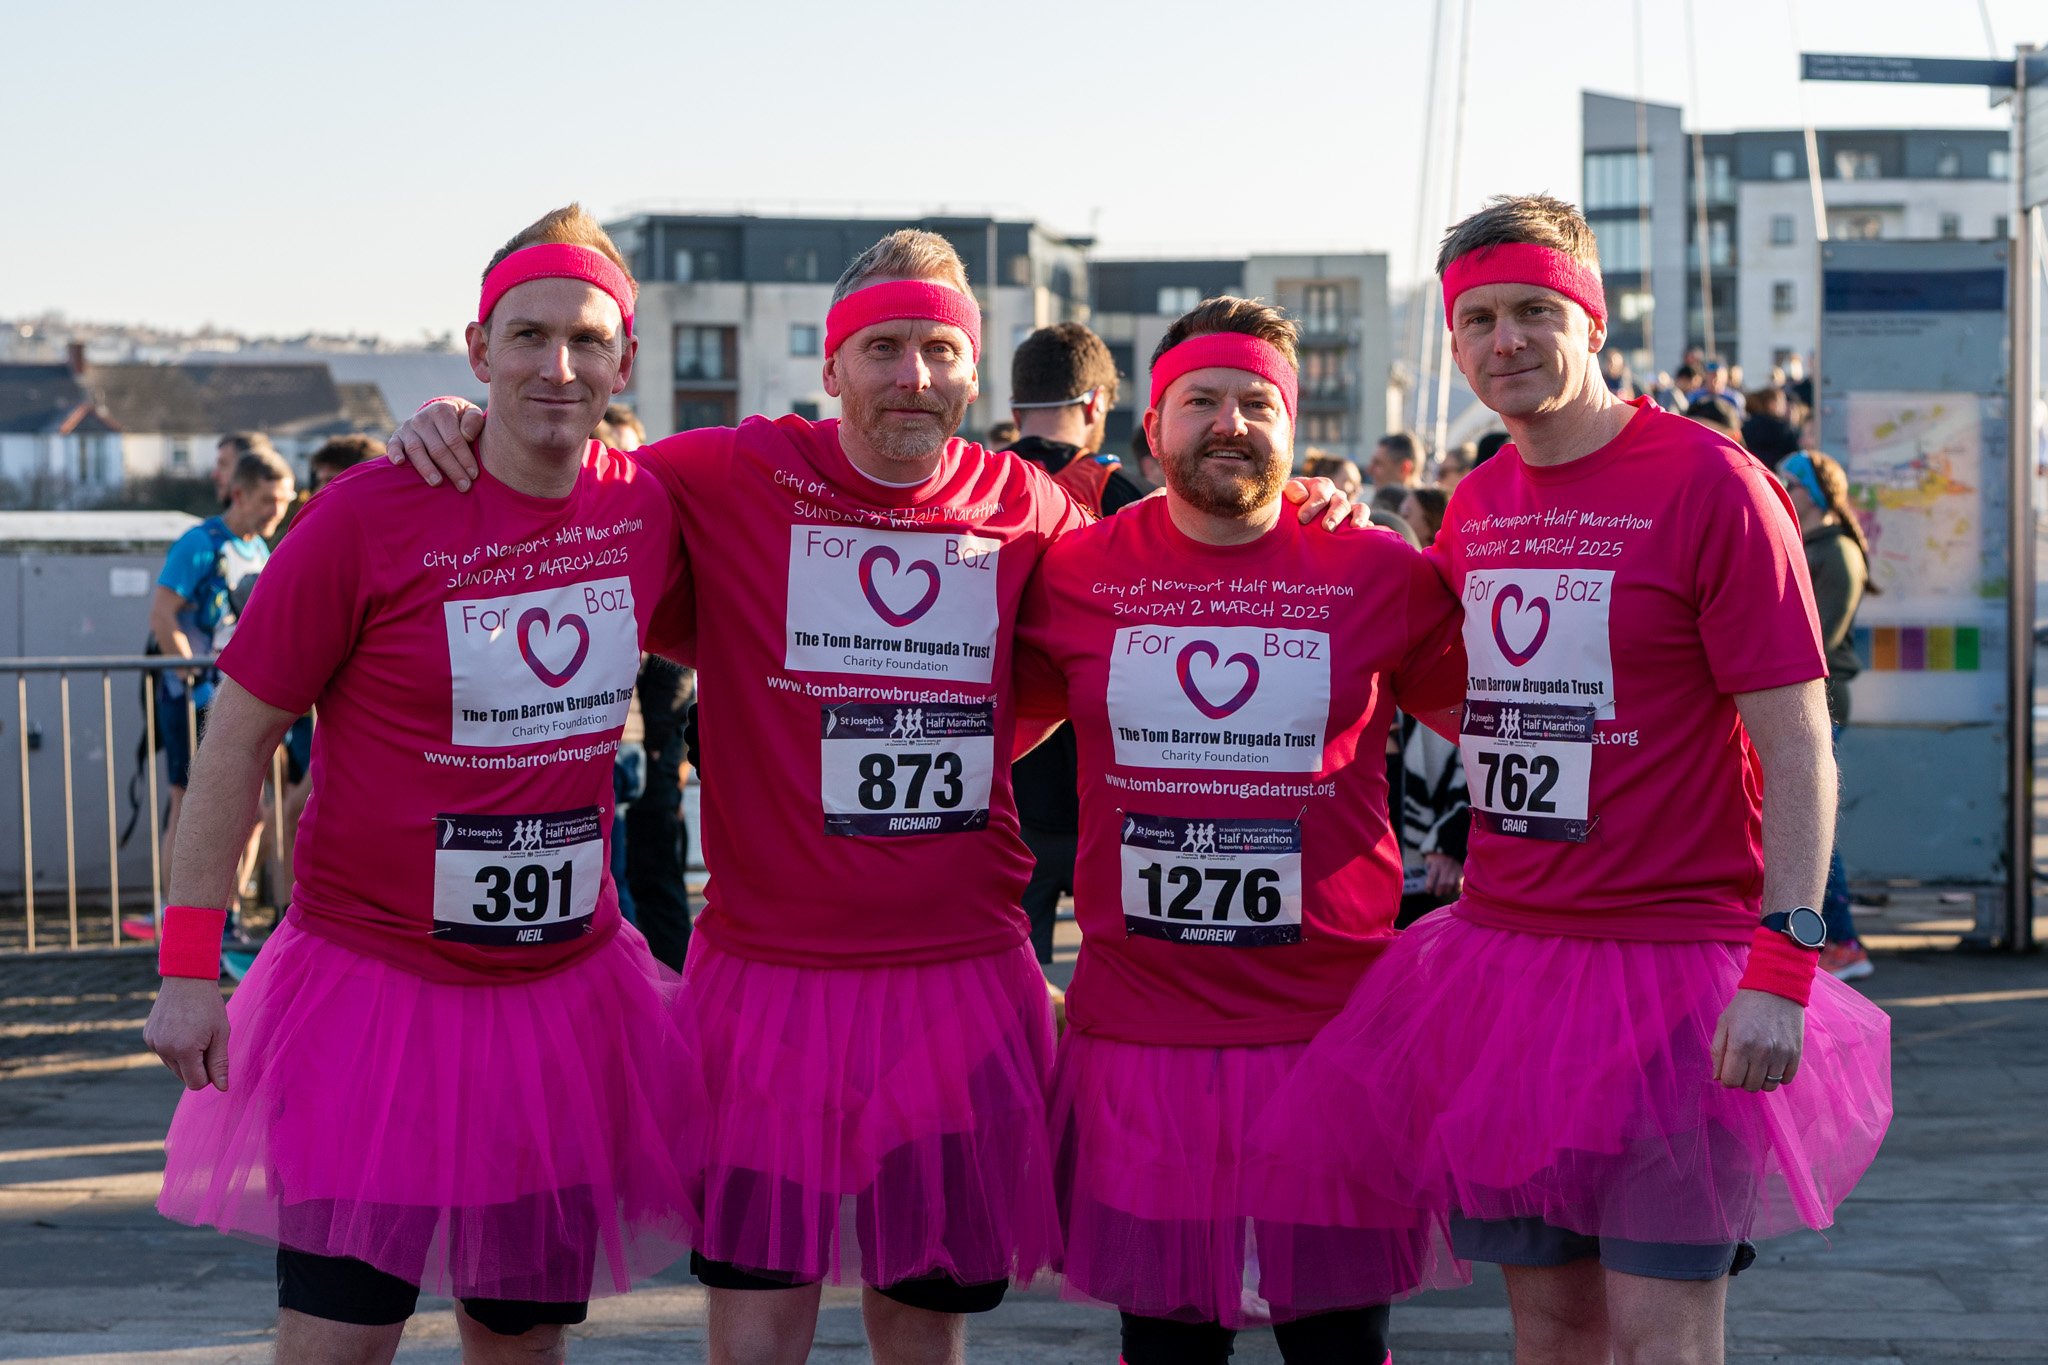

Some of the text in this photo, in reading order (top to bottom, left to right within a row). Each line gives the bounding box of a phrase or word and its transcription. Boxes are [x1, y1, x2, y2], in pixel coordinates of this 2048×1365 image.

[773, 470, 827, 497] City of
[943, 501, 1005, 522] Marathon
[1461, 507, 1653, 536] City of Newport Half Marathon
[423, 518, 643, 569] City of Newport Half Marathon
[806, 530, 857, 559] For
[944, 539, 991, 570] Baz
[1466, 536, 1624, 558] SUNDAY 2 MARCH 2025
[522, 564, 535, 580] 2
[538, 552, 594, 576] MARCH
[1092, 578, 1354, 597] City of Newport Half Marathon
[1467, 575, 1495, 602] For
[1555, 574, 1603, 602] Baz
[584, 587, 629, 614] Baz
[1113, 600, 1330, 620] SUNDAY 2 MARCH 2025
[462, 605, 510, 634] For
[795, 632, 990, 659] The Tom Barrow Brugada Trust
[1126, 630, 1175, 655] For
[1264, 633, 1320, 660] Baz
[843, 655, 949, 672] Charity Foundation
[1470, 676, 1487, 691] Tom
[1488, 677, 1521, 693] Barrow
[1522, 678, 1570, 695] Brugada
[1571, 679, 1604, 695] Trust
[462, 688, 634, 723] The Tom Barrow Brugada Trus
[512, 713, 608, 738] Charity Foundation
[840, 716, 884, 727] St Joseph's
[926, 718, 986, 728] Half Marathon
[1471, 713, 1494, 724] St Joseph's
[1523, 720, 1585, 732] Half Marathon
[1118, 727, 1316, 747] The Tom Barrow Brugada Trust
[1161, 750, 1269, 764] Charity Foundation
[858, 752, 963, 811] 873
[1105, 772, 1336, 799] www.tombarrowbrugadatrust.org
[1478, 751, 1560, 814] 762
[457, 828, 503, 839] St Joseph's
[546, 826, 564, 838] Half
[565, 822, 597, 836] Marathon
[888, 816, 941, 830] RICHARD
[1136, 826, 1175, 839] St Joseph's
[1502, 818, 1528, 833] CRAIG
[1219, 833, 1292, 844] Half Marathon
[472, 860, 572, 922] 391
[1138, 862, 1282, 923] 1276
[516, 929, 544, 942] NEIL
[1180, 928, 1237, 942] ANDREW
